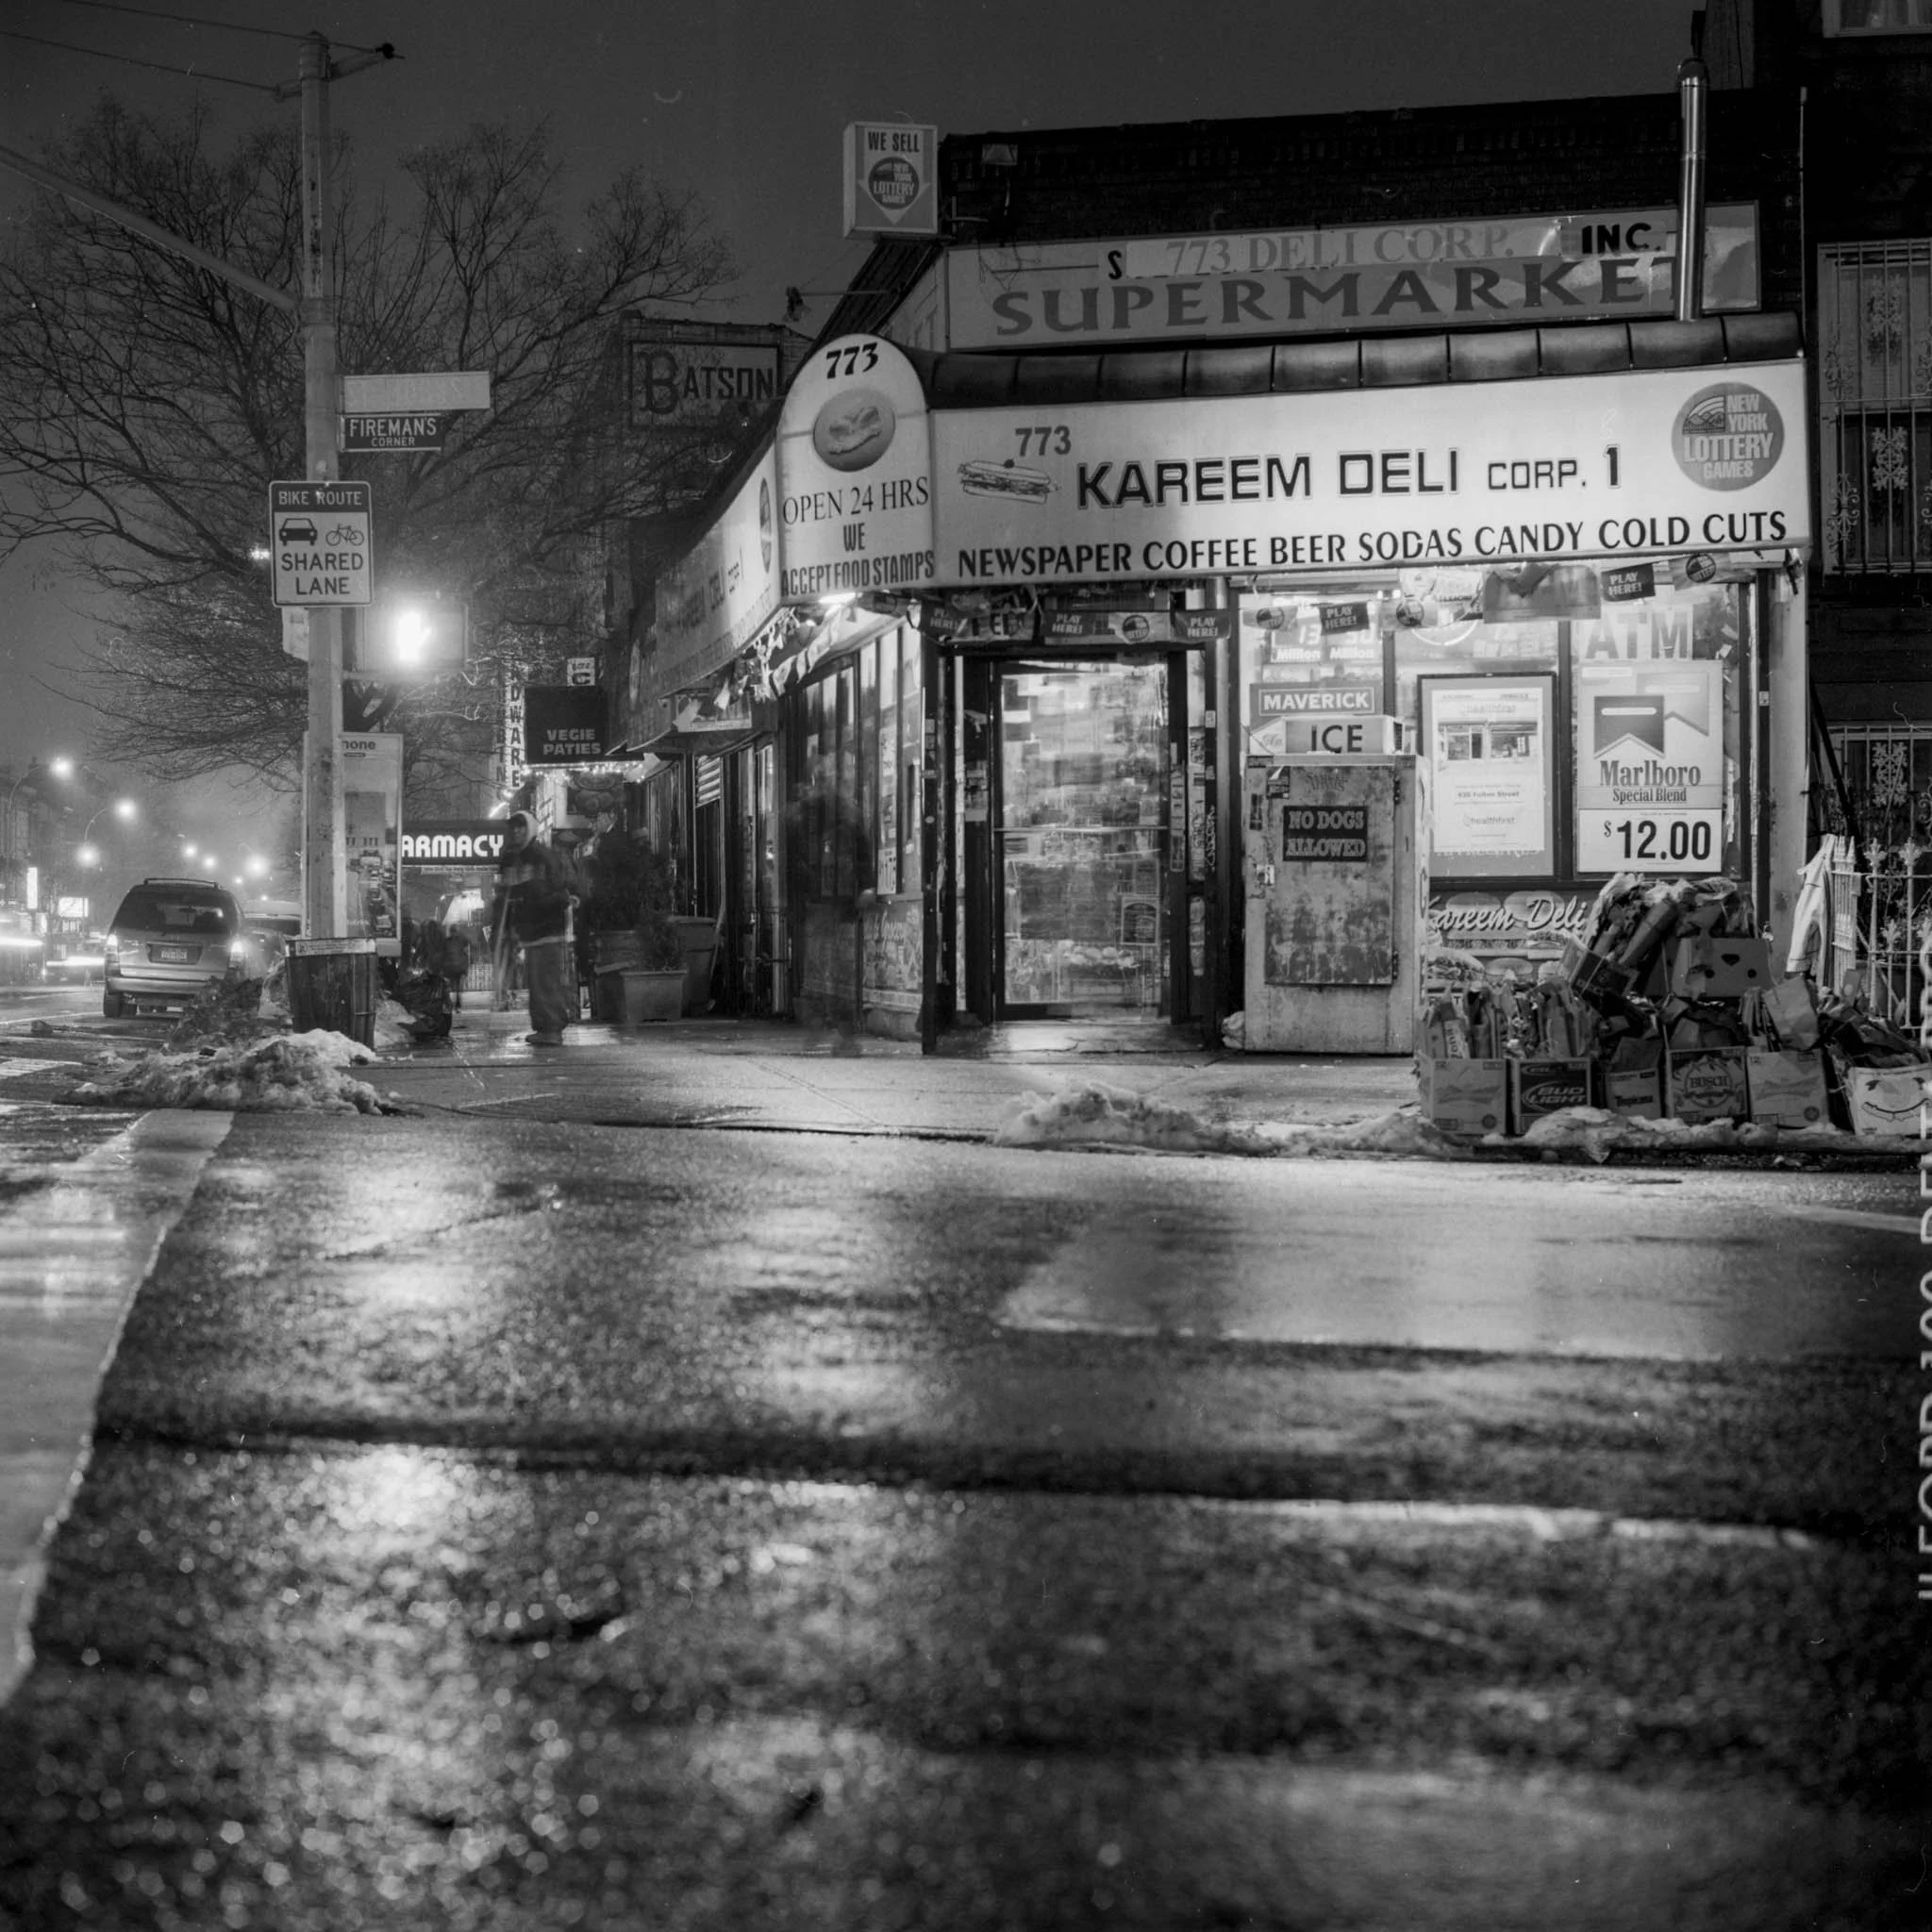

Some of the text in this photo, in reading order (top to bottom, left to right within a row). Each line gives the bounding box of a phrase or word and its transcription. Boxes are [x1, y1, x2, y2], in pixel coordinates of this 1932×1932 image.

[868, 131, 920, 153] WE SELL
[1166, 237, 1232, 274] 773
[1249, 229, 1359, 270] DELI
[1374, 226, 1514, 263] CORP.
[1581, 222, 1662, 255] INC.
[826, 341, 879, 379] 773
[637, 349, 774, 414] BATSON
[1726, 393, 1759, 412] NEW
[349, 417, 437, 438] FIREMAN'S
[1727, 412, 1768, 432] YORK
[371, 437, 415, 447] CORNER
[1015, 425, 1072, 458] 773
[1683, 432, 1774, 463] LOTTERY
[1076, 443, 1622, 510] KAREEM DELI CORP. 1
[1703, 460, 1754, 480] GAMES
[278, 491, 362, 506] BIKE ROUTE
[783, 476, 929, 525] OPEN 24 HRS
[843, 523, 865, 552] WE
[958, 510, 1787, 578] NEWSPAPER COFFEE BEER SODAS CANDY COLD CUTS
[281, 553, 363, 572] SHARED
[781, 563, 832, 597] ACCEPT
[834, 558, 870, 590] FOOD
[873, 550, 935, 587] STAMPS
[1608, 571, 1639, 585] PLAY
[296, 576, 351, 595] LANE
[1607, 581, 1642, 596] HERE!
[1056, 612, 1081, 625] PLAY
[1191, 617, 1215, 627] PLAY
[1326, 605, 1353, 619] PLAY
[1187, 626, 1219, 639] HERE!
[1324, 615, 1357, 630] HERE!
[1585, 609, 1689, 659] ATM
[1263, 691, 1370, 710] MAVERICK
[546, 728, 595, 741] VEGIE
[1311, 724, 1363, 754] ICE
[542, 742, 601, 756] PATIES
[1599, 759, 1702, 787] Marlboro
[1612, 787, 1687, 806] Special Blend
[1289, 810, 1364, 830] NO DOGS
[1286, 838, 1366, 858] ALLOWED
[1604, 820, 1711, 860] $12.00
[1526, 895, 1588, 930] Deli
[1529, 1094, 1586, 1105] LIGHT
[1538, 1086, 1585, 1095] BUD
